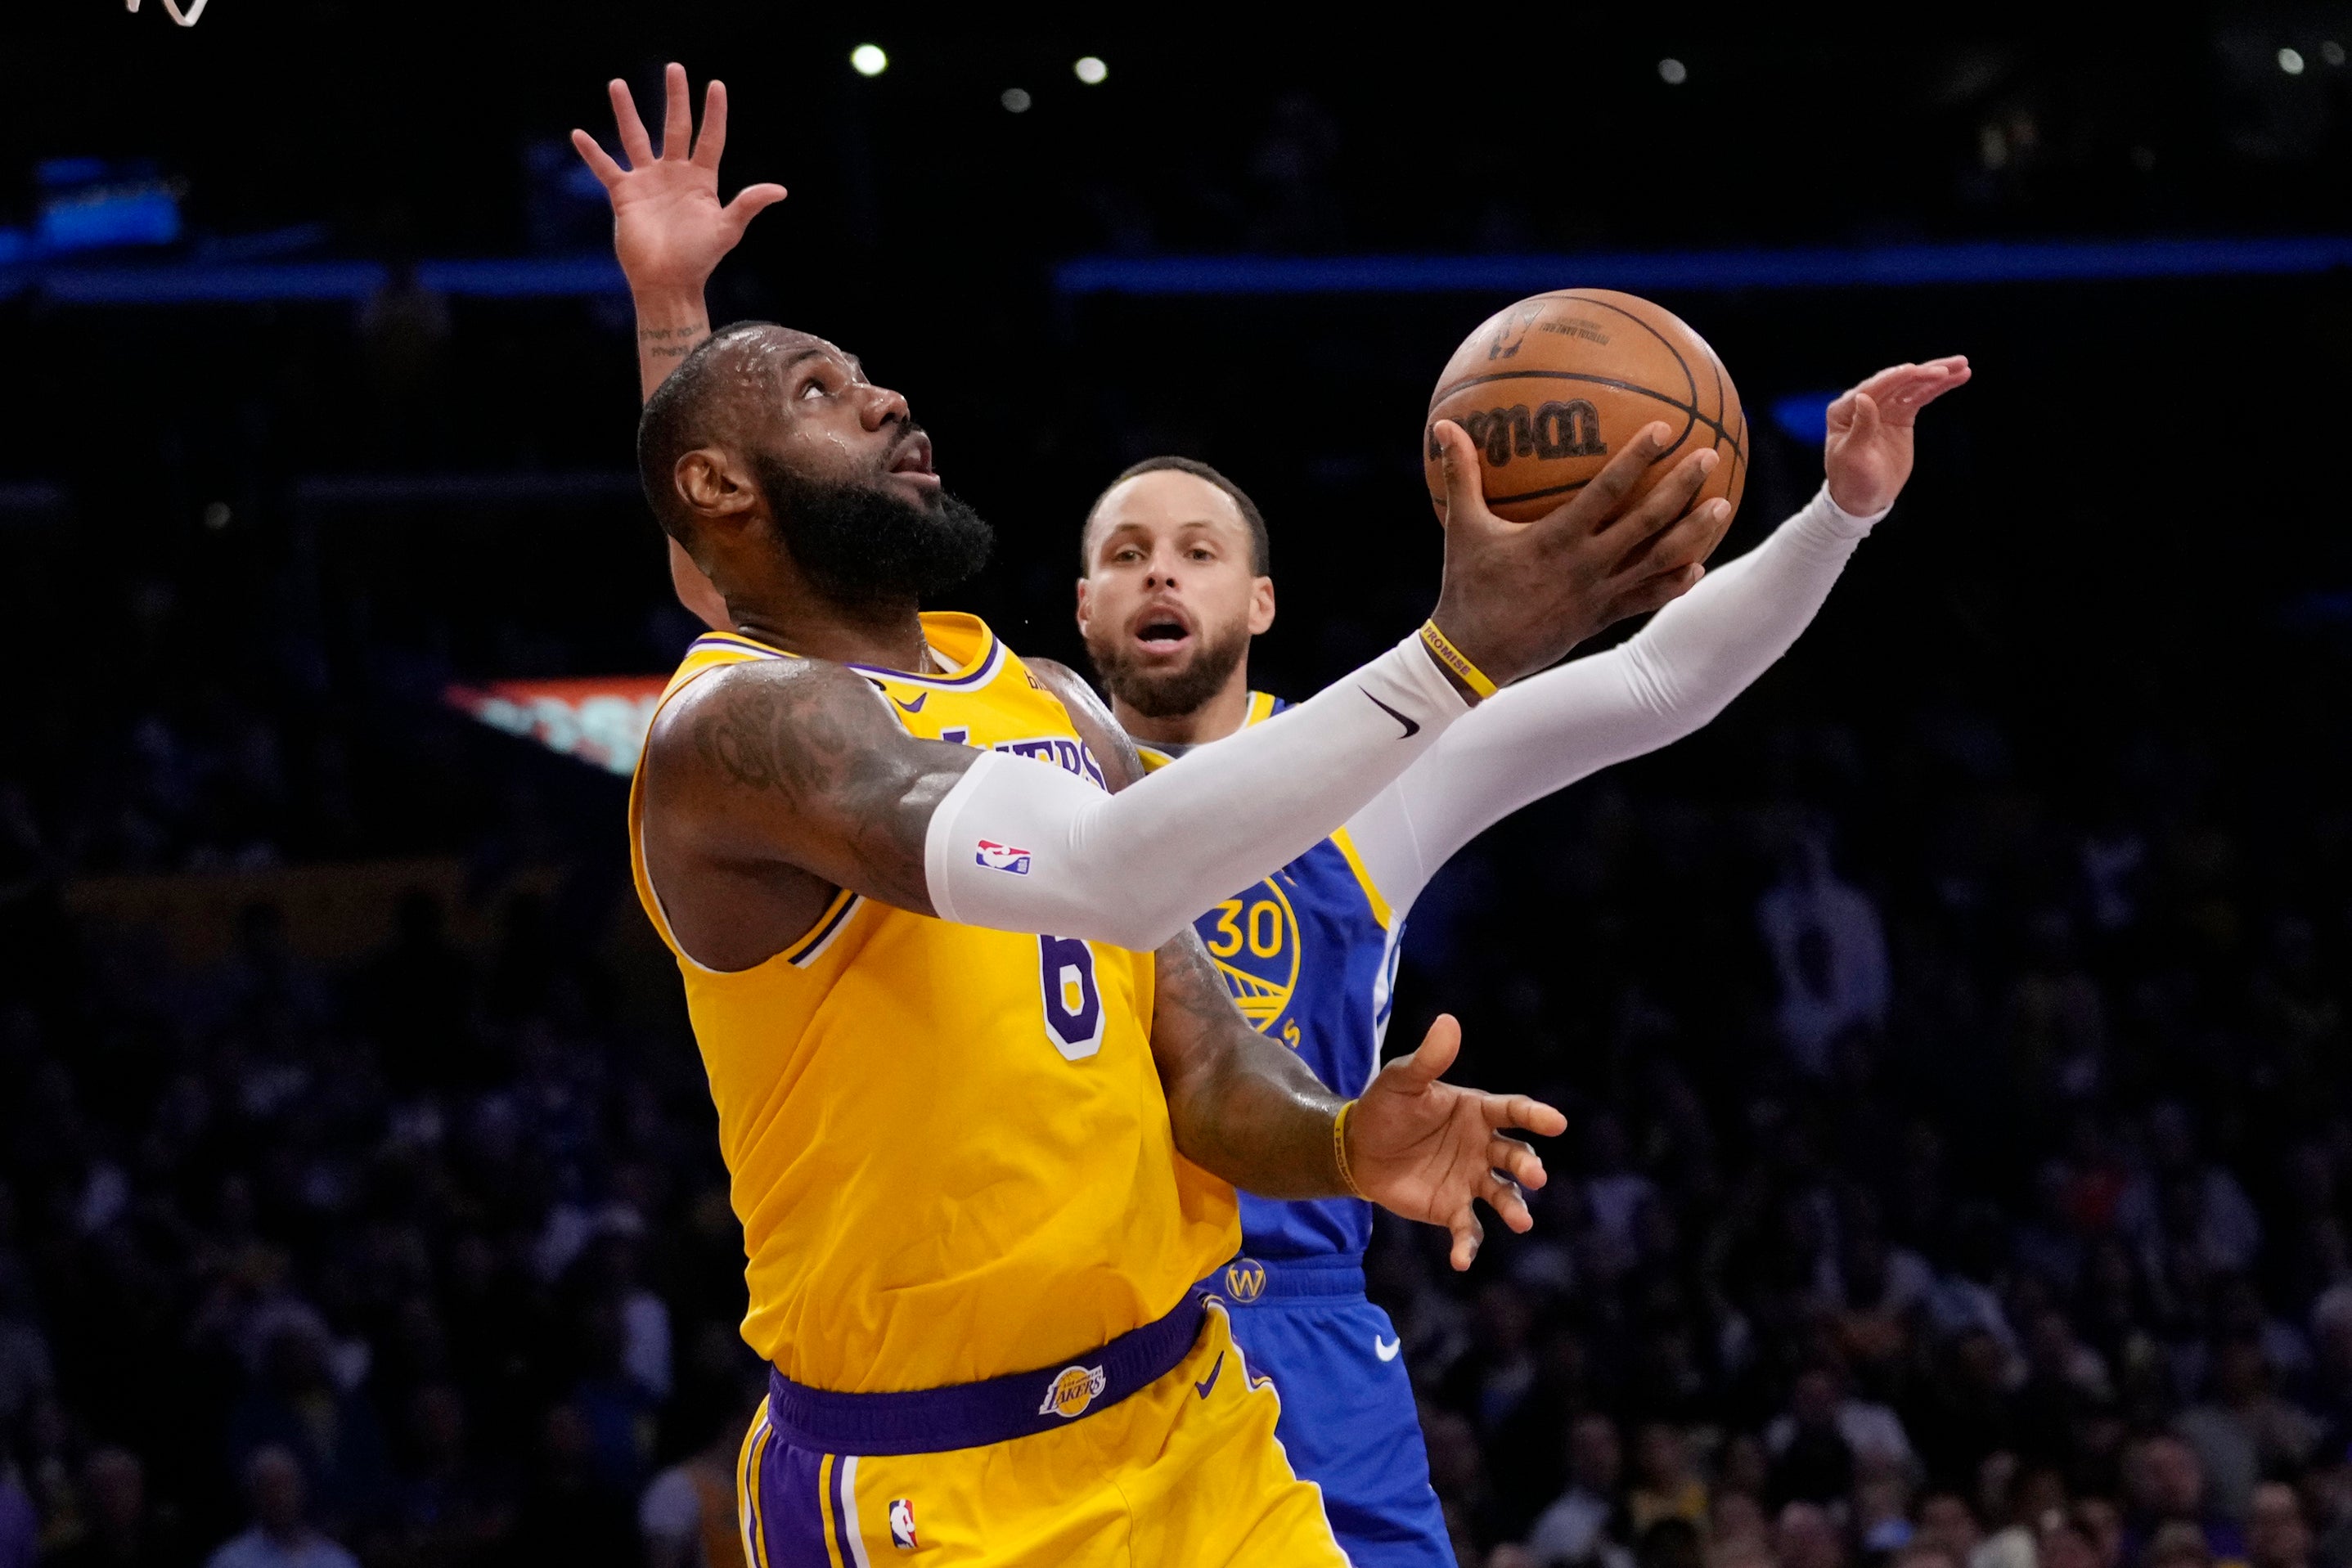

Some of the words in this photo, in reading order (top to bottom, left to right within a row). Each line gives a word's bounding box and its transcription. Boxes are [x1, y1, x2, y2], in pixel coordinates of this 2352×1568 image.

[1423, 626, 1471, 676] PROMISE
[1207, 899, 1283, 959] 30
[1036, 933, 1106, 1062] 6
[1229, 1269, 1264, 1297] W
[1040, 1376, 1104, 1413] LAKERS
